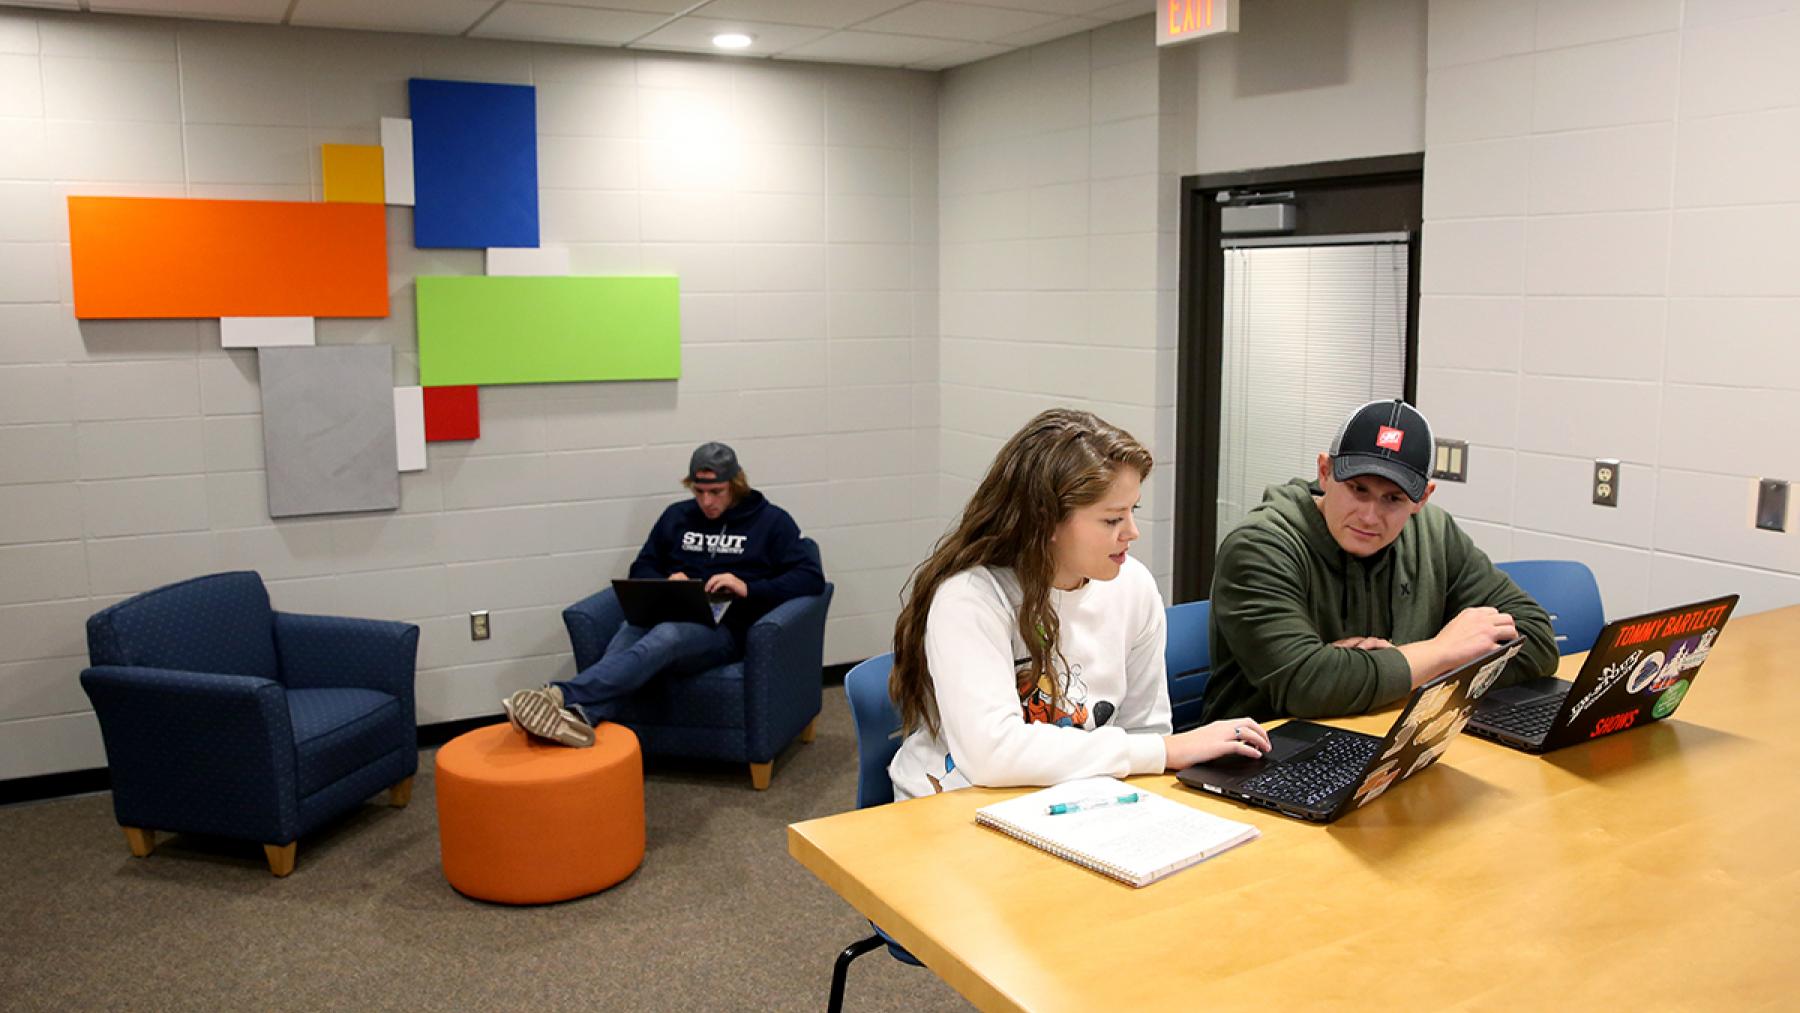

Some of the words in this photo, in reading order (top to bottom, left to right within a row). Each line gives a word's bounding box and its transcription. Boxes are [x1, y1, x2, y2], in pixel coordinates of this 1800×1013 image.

[682, 531, 747, 548] STOUT
[1615, 618, 1666, 647] TOMMY
[1661, 605, 1728, 637] BARTLETT
[1591, 709, 1639, 737] SHOWS
